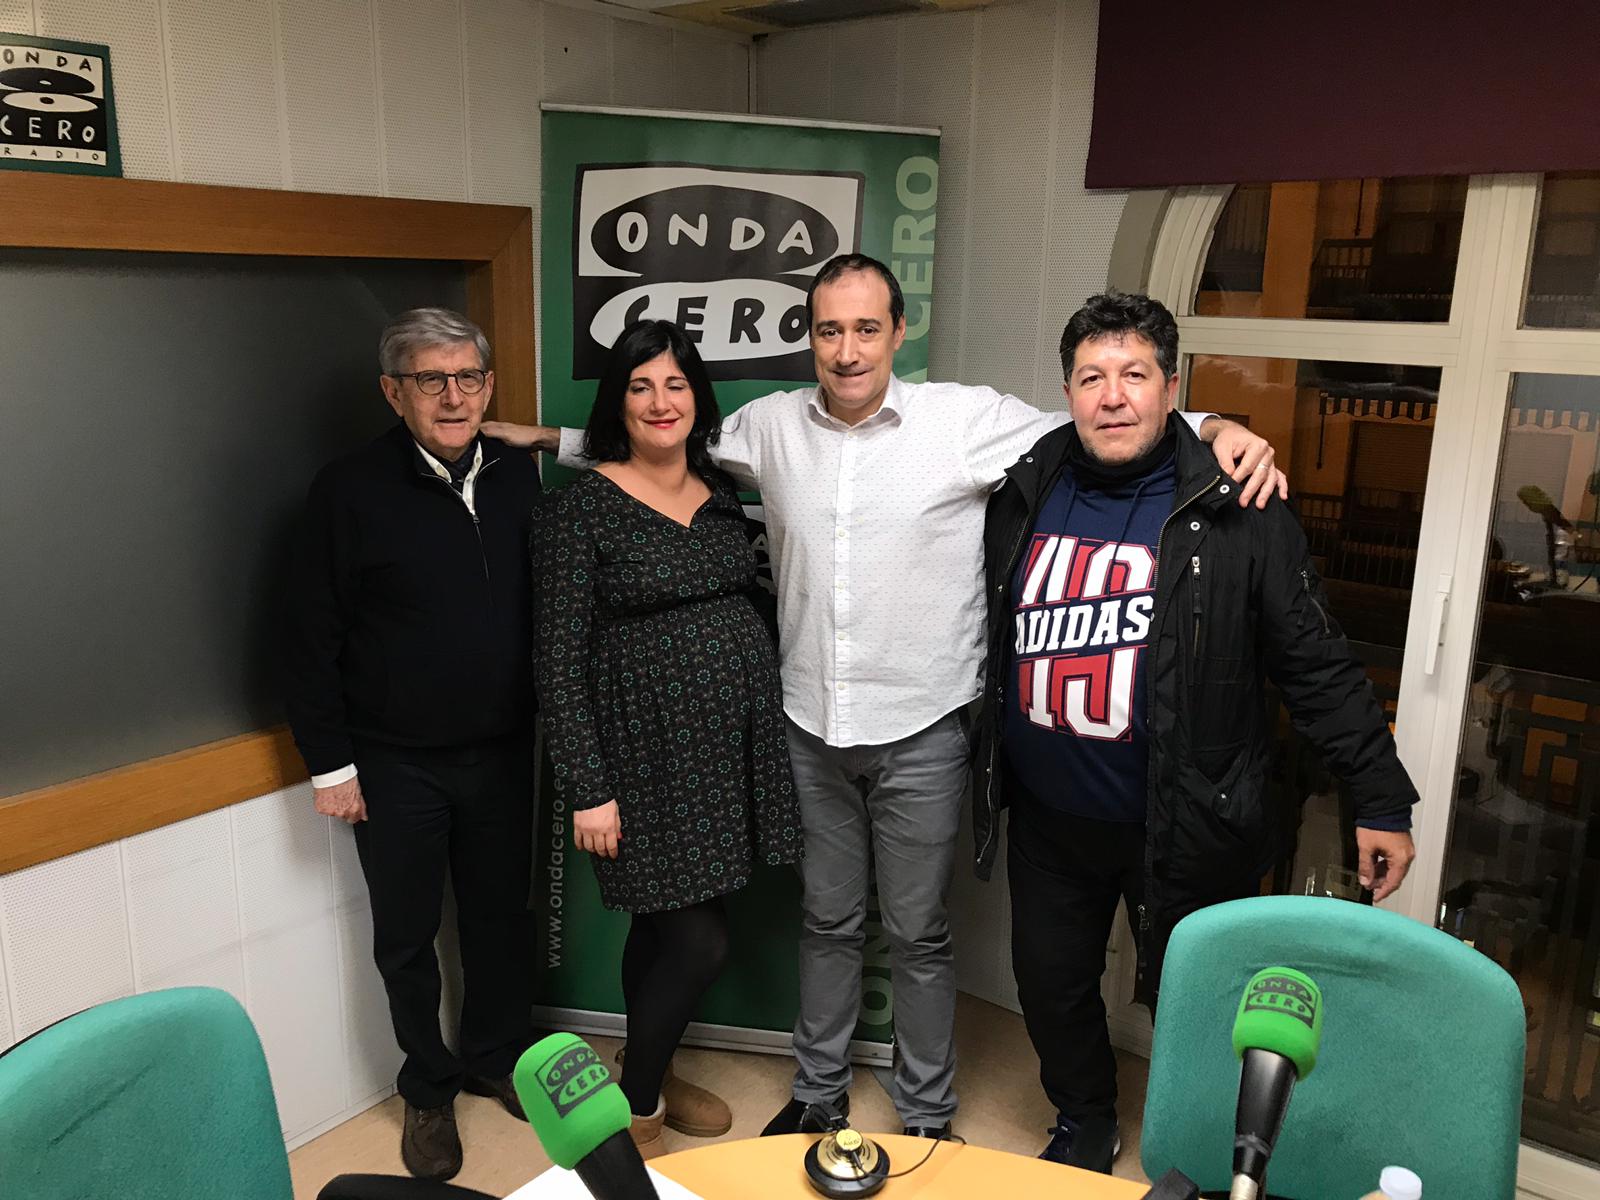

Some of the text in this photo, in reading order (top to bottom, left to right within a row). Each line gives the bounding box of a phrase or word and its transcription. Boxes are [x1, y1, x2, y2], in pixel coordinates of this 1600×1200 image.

[3, 48, 92, 72] ONDA
[0, 114, 96, 143] CERO
[4, 146, 99, 161] RADIO
[616, 211, 814, 256] ONDA
[1015, 595, 1154, 655] ADIDAS
[549, 772, 566, 969] www.ondacero.e
[1255, 994, 1306, 1013] CERO
[1257, 980, 1311, 1001] ONDA
[550, 1049, 597, 1080] ONDA
